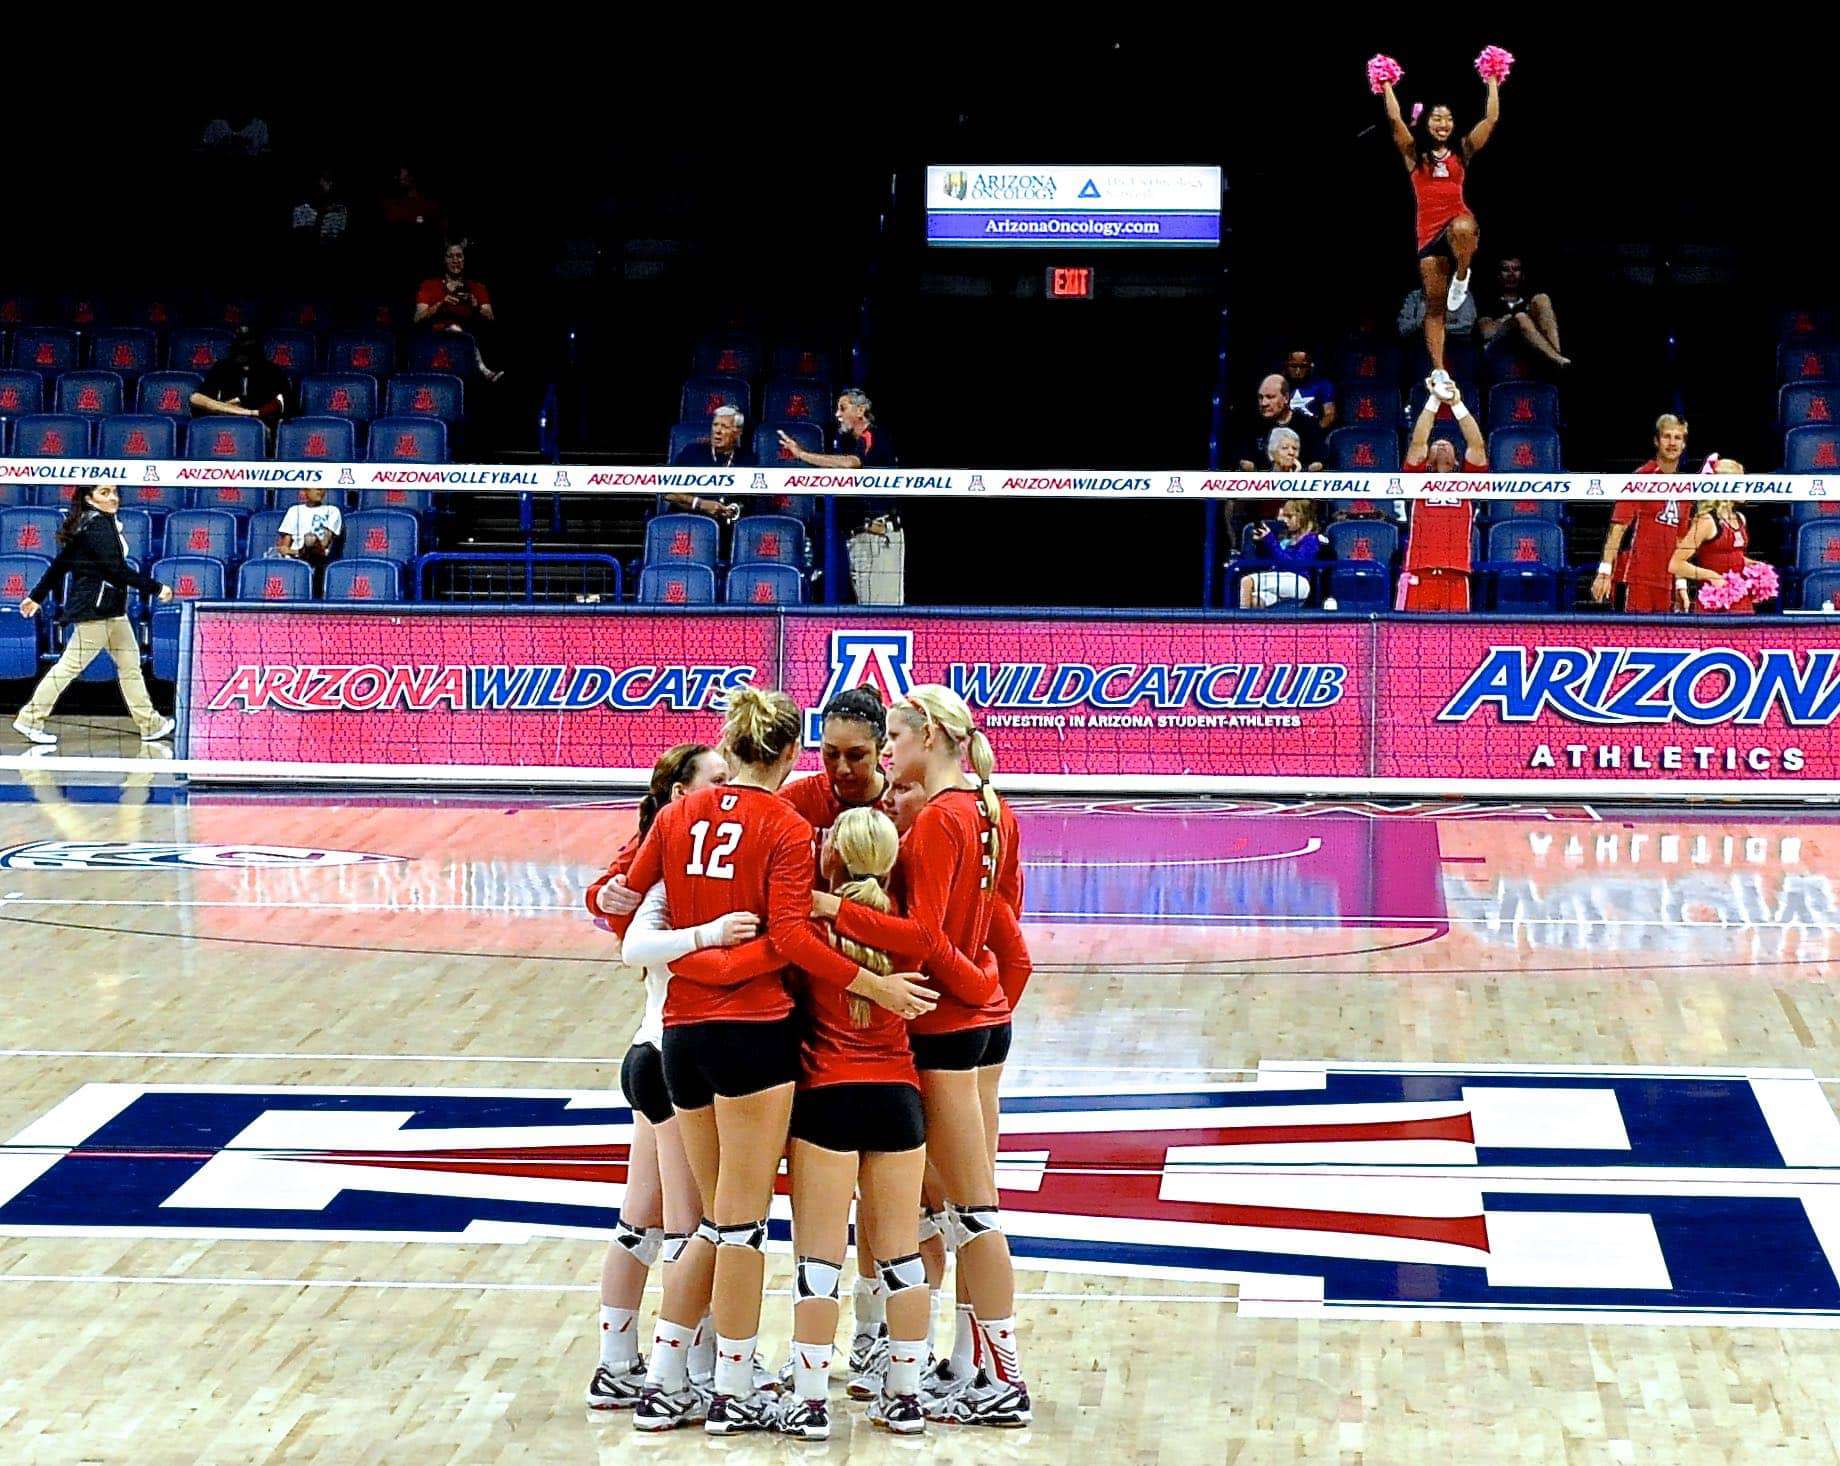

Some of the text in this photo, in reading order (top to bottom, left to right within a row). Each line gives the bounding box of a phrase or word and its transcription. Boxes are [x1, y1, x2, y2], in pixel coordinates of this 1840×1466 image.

[971, 186, 1054, 200] ONCOLOGY
[973, 174, 1057, 190] ARIZONA
[985, 219, 1160, 236] ArizonaOncology.com
[1055, 269, 1088, 295] EXIT
[176, 467, 323, 482] ARIZONAWILDCATS
[371, 471, 539, 485] ARIZONAVOLLEYBALL
[587, 473, 736, 487] ARIZONAWILDCATS
[784, 475, 953, 489] ARIZONAVOLLEYBALL
[1001, 477, 1152, 491] ARIZONAWILDCATS
[1200, 479, 1371, 493] ARIZONAVOLLEYBALL
[1420, 480, 1572, 494] ARIZONAWILDCATS
[1621, 481, 1793, 494] ARIZONAVOLLEYBALL
[208, 664, 757, 711] ARIZONAWILDCATS
[948, 662, 1347, 708] WILDCATCLUB
[986, 714, 1301, 728] INVESTING IN ARIZONA STUDENT-ATHLETES
[1531, 744, 1806, 771] ATHLETICS
[686, 820, 743, 879] 12
